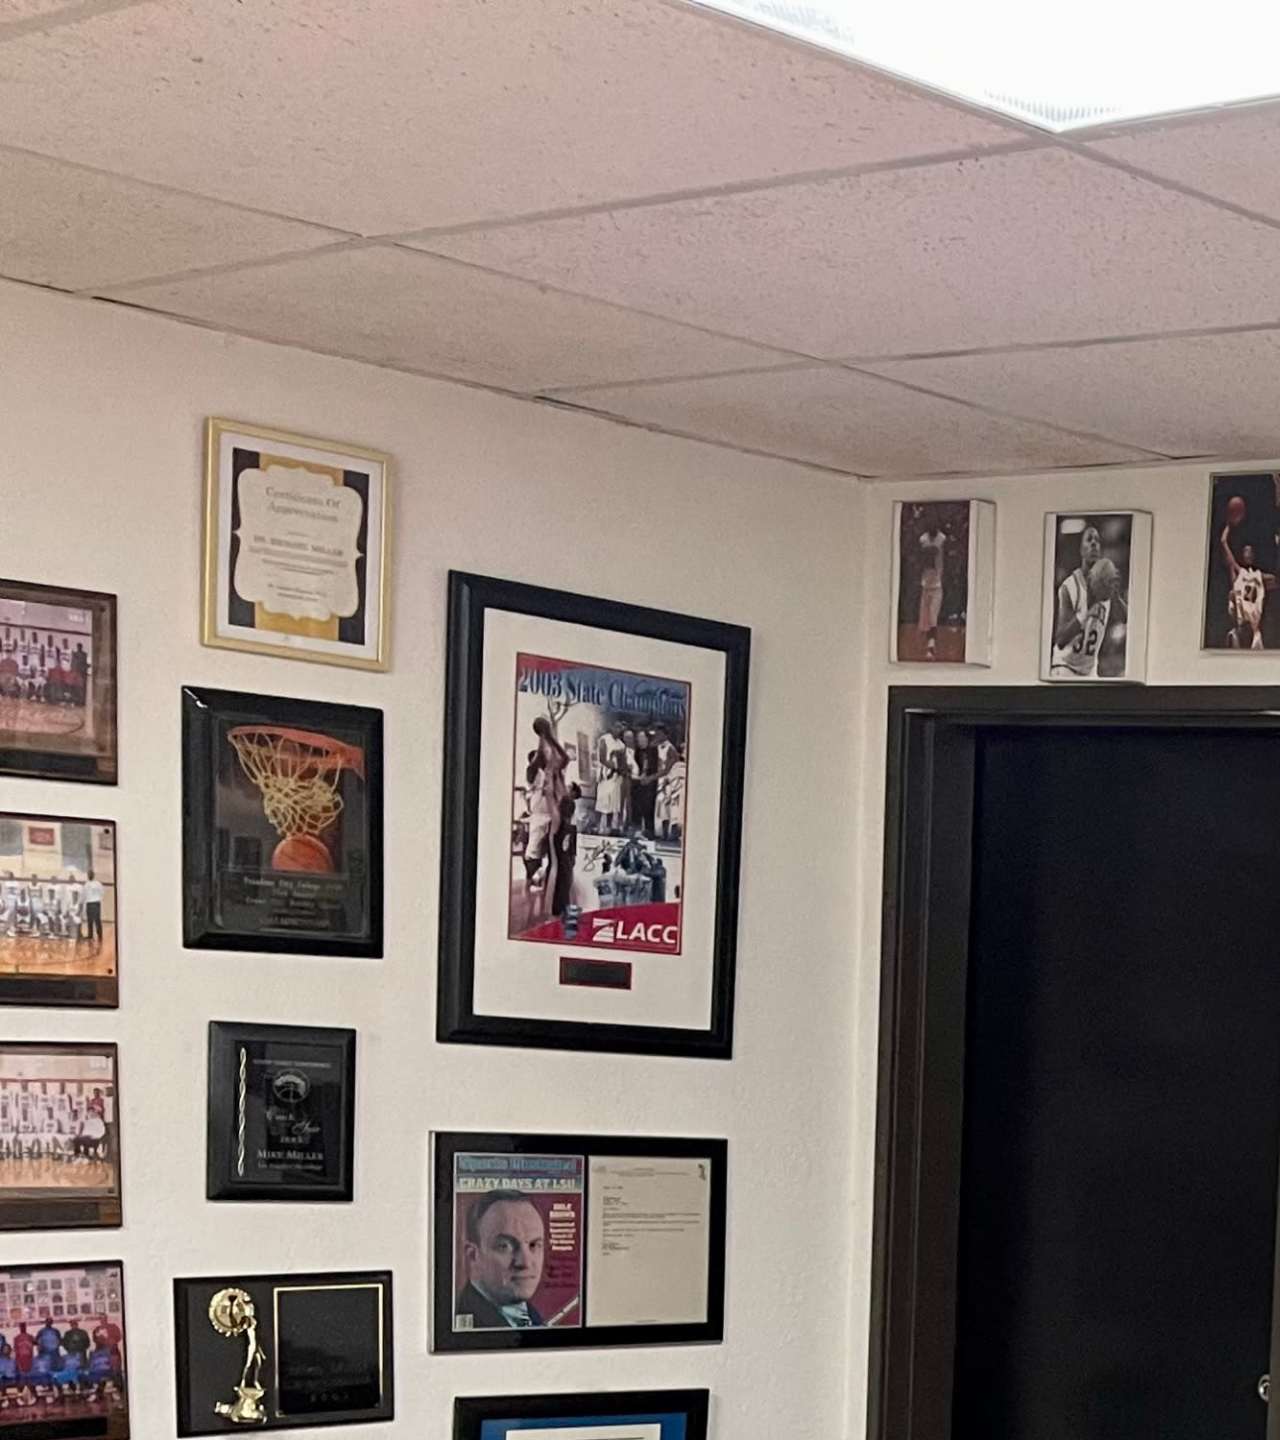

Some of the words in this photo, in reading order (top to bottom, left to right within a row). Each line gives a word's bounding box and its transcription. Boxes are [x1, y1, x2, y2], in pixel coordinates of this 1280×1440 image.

[518, 668, 562, 698] 2003
[562, 675, 603, 706] State
[615, 920, 679, 944] LACC
[459, 1177, 499, 1189] CRAZY
[502, 1178, 533, 1189] DAYS
[535, 1178, 552, 1189] AT
[553, 1178, 576, 1190] LSU
